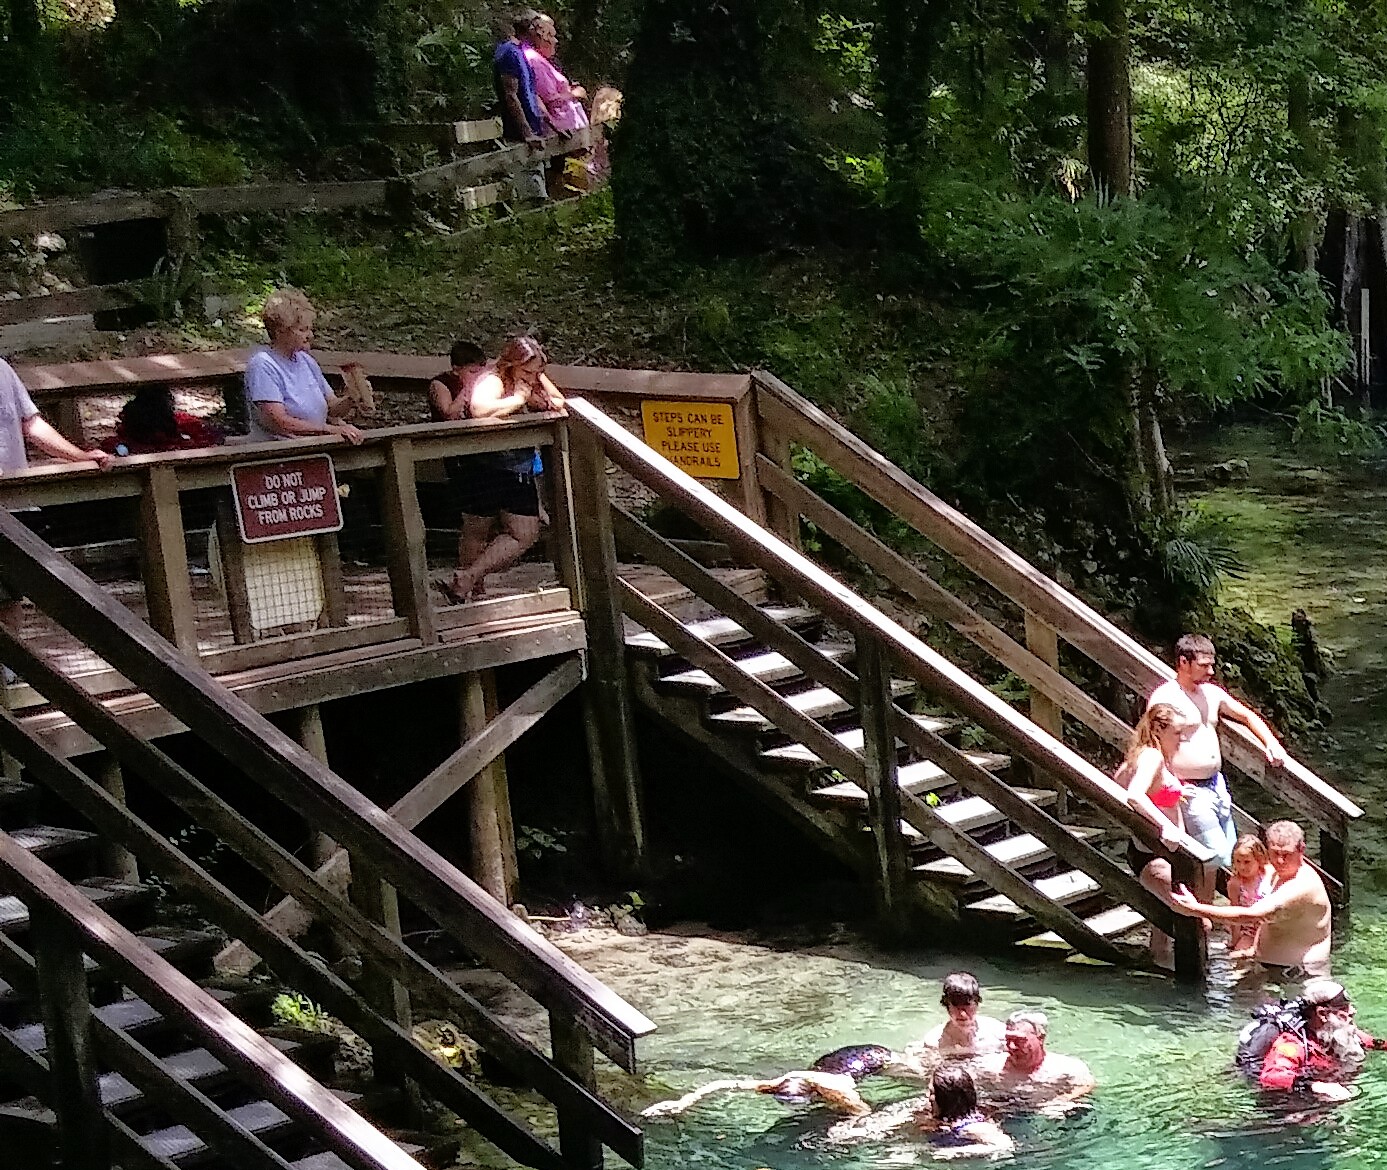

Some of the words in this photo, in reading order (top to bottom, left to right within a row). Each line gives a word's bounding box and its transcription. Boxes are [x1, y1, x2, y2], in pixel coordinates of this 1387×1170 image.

[652, 412, 683, 423] STEPS
[687, 413, 708, 424] CAN
[711, 414, 724, 425] BE
[666, 426, 712, 438] SLIPPERY
[661, 441, 700, 452] PLEASE
[702, 442, 721, 453] USE
[264, 474, 281, 490] DO
[281, 472, 303, 488] NOT
[247, 492, 279, 509] CLIMB
[281, 490, 297, 505] OR
[299, 486, 327, 503] JUMP
[258, 508, 288, 525] FROM
[288, 503, 324, 521] ROCKS
